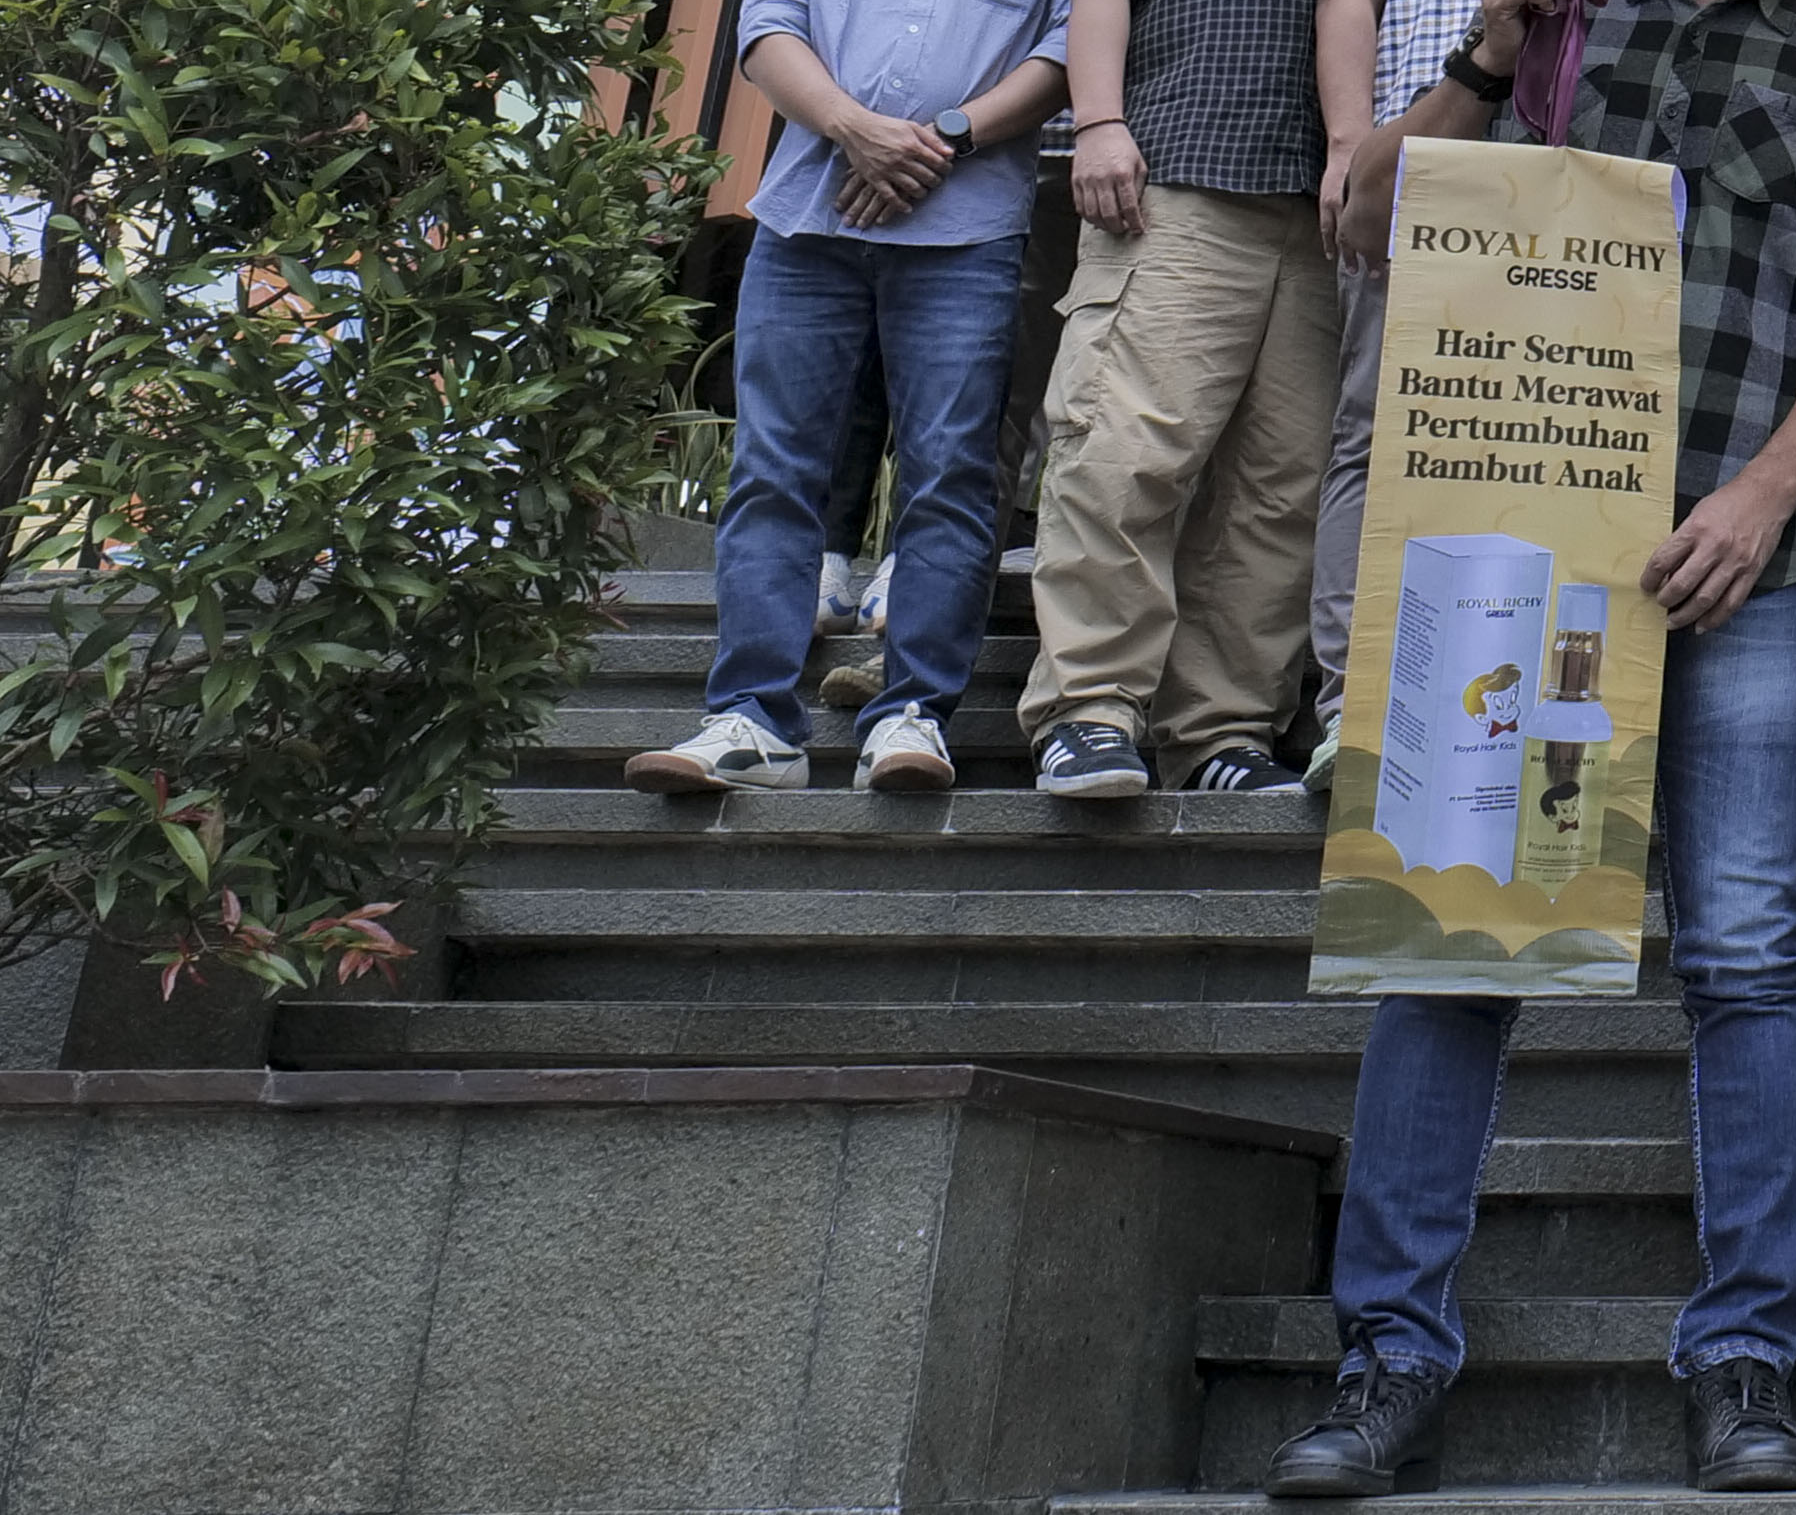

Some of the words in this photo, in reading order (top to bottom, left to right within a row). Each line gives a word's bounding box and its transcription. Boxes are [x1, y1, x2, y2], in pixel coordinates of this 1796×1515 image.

[1411, 225, 1548, 260] ROYAL
[1562, 237, 1666, 272] RICHY
[1506, 265, 1598, 292] GRESSE
[1434, 328, 1516, 360] Hair
[1523, 334, 1635, 371] Serum
[1398, 367, 1503, 401] Bantu
[1512, 374, 1662, 414] Merawat
[1405, 409, 1650, 453] Pertumbuhan
[1403, 450, 1547, 485] Rambut
[1554, 459, 1645, 493] Anak
[1456, 598, 1499, 609] ROYAL
[1503, 596, 1545, 608] RICHY
